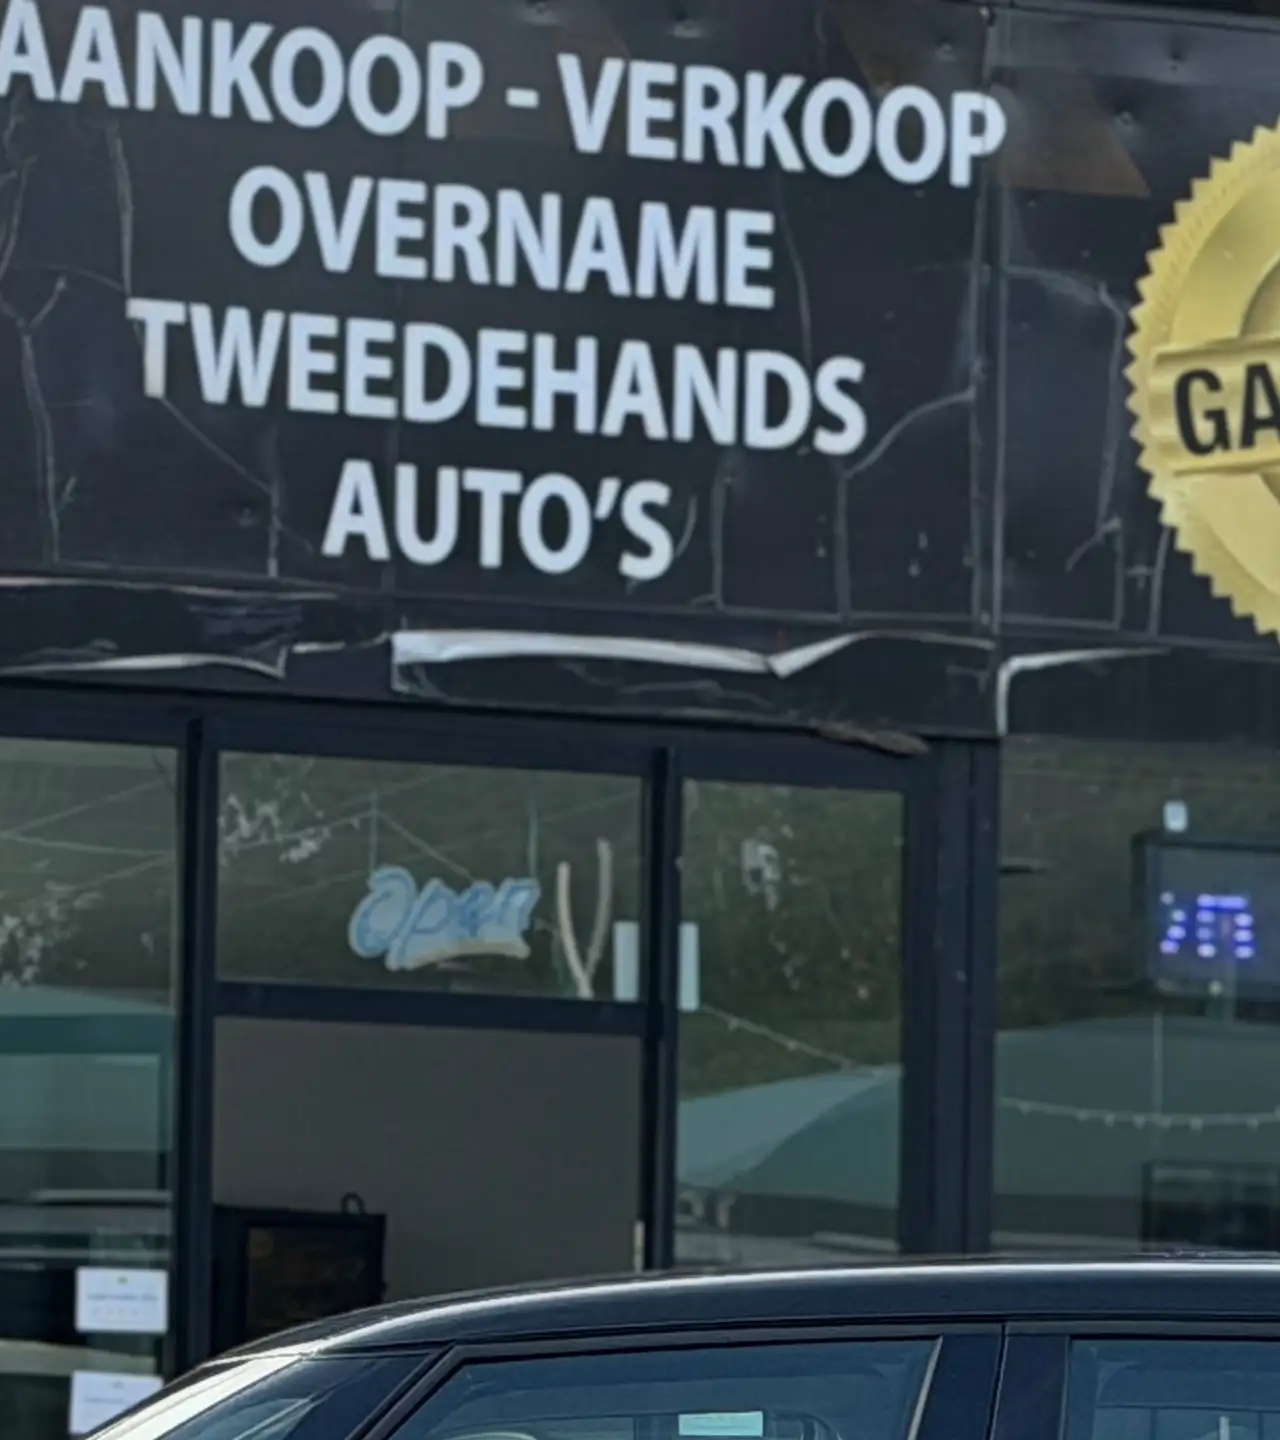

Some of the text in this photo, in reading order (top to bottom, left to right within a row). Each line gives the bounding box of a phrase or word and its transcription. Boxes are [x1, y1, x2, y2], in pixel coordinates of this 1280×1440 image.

[557, 54, 1007, 187] VERKOOP
[230, 166, 775, 309] OVERNAME
[127, 298, 866, 455] TWEEDEHANDS
[323, 461, 673, 582] AUTO'S
[348, 865, 541, 971] Open
